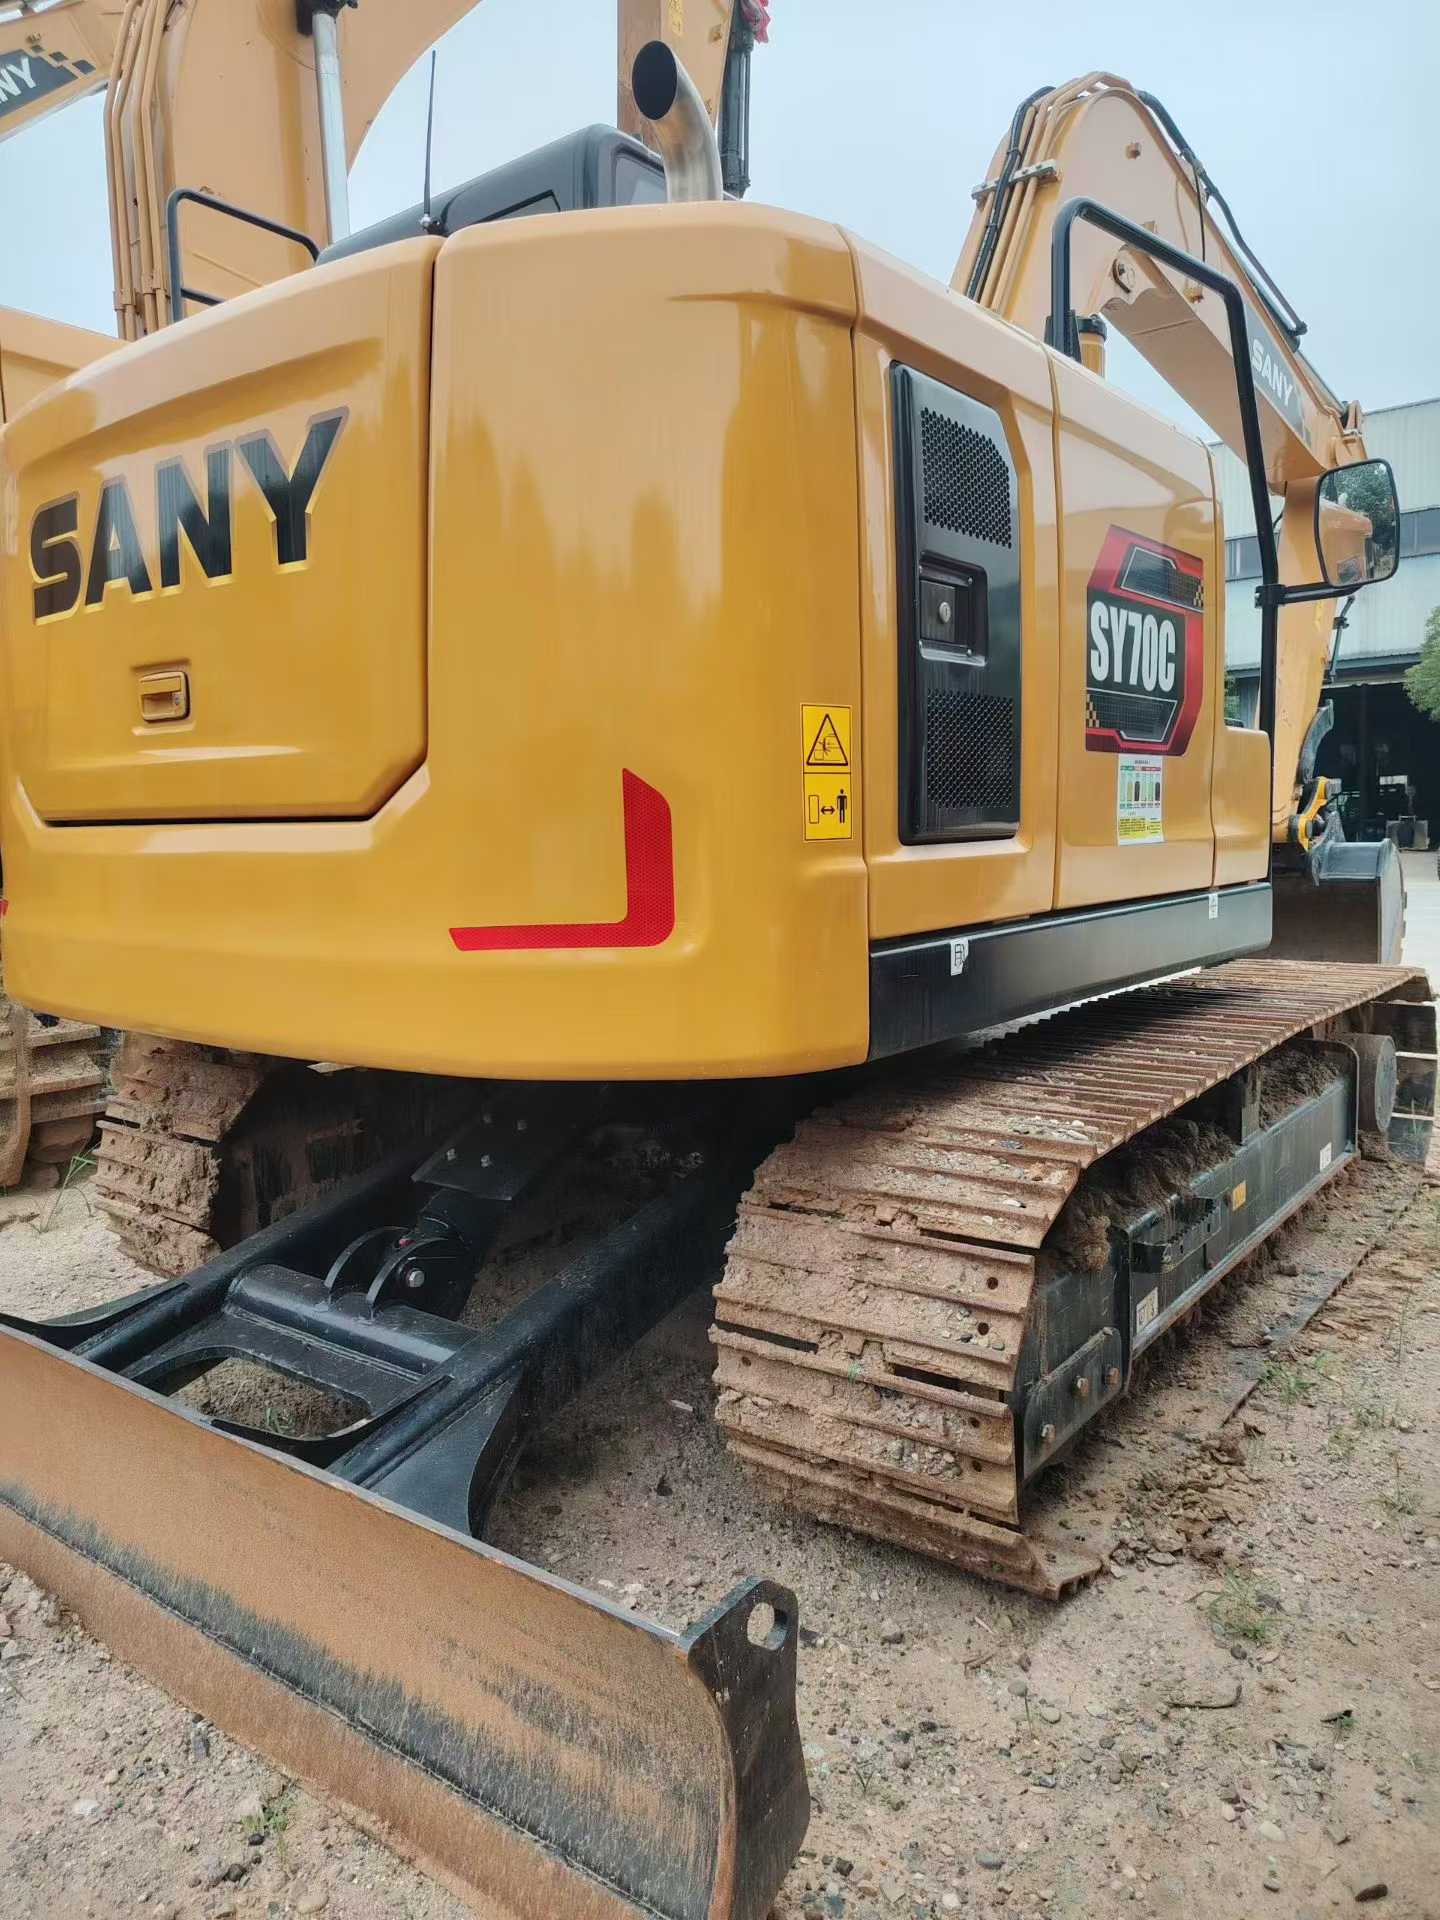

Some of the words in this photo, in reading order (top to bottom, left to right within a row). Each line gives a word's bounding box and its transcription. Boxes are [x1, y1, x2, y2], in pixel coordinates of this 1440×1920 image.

[1252, 339, 1293, 406] SANY
[30, 408, 348, 623] SANY
[1090, 600, 1176, 692] SY70C
